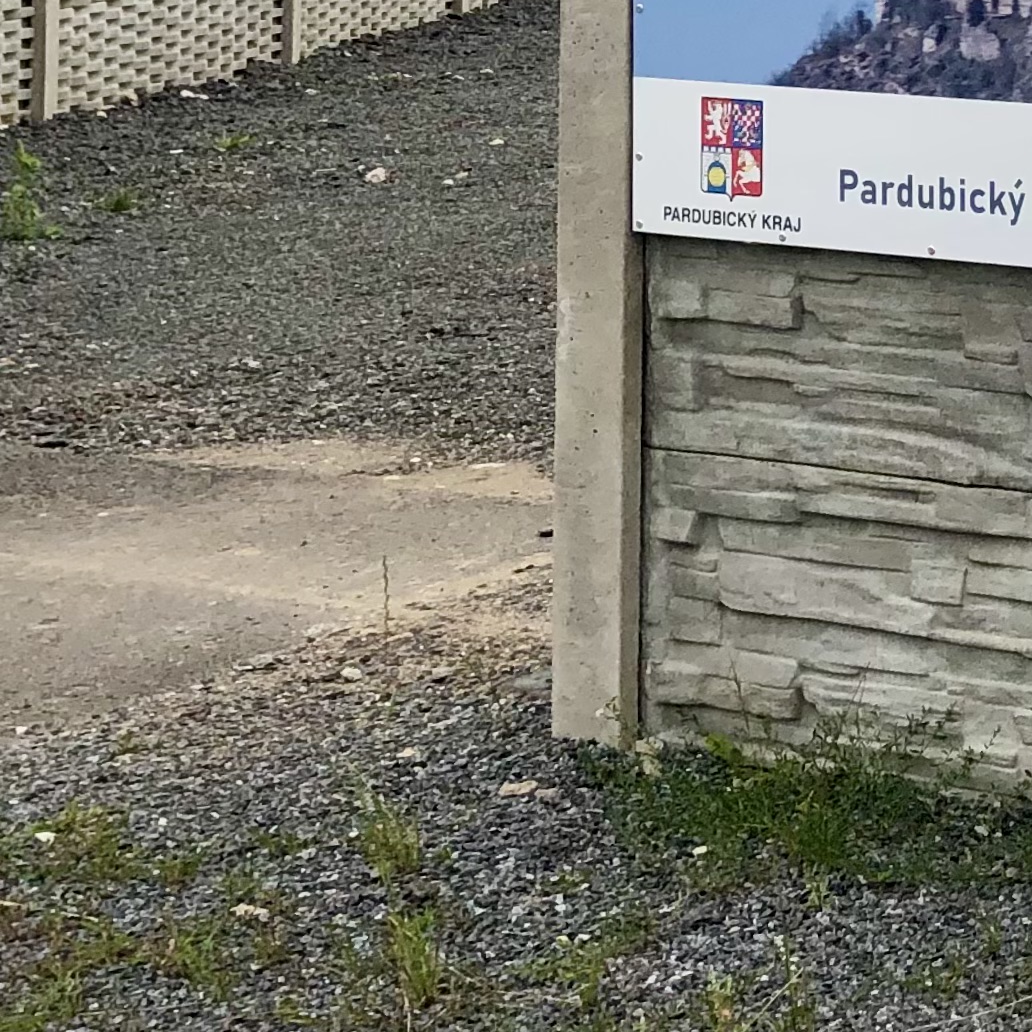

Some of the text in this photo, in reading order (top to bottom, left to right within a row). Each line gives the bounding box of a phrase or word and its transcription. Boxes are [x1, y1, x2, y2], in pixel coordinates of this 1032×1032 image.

[839, 168, 1026, 226] Pardubický
[663, 205, 802, 233] PARDUBICKÝ KRAJ
